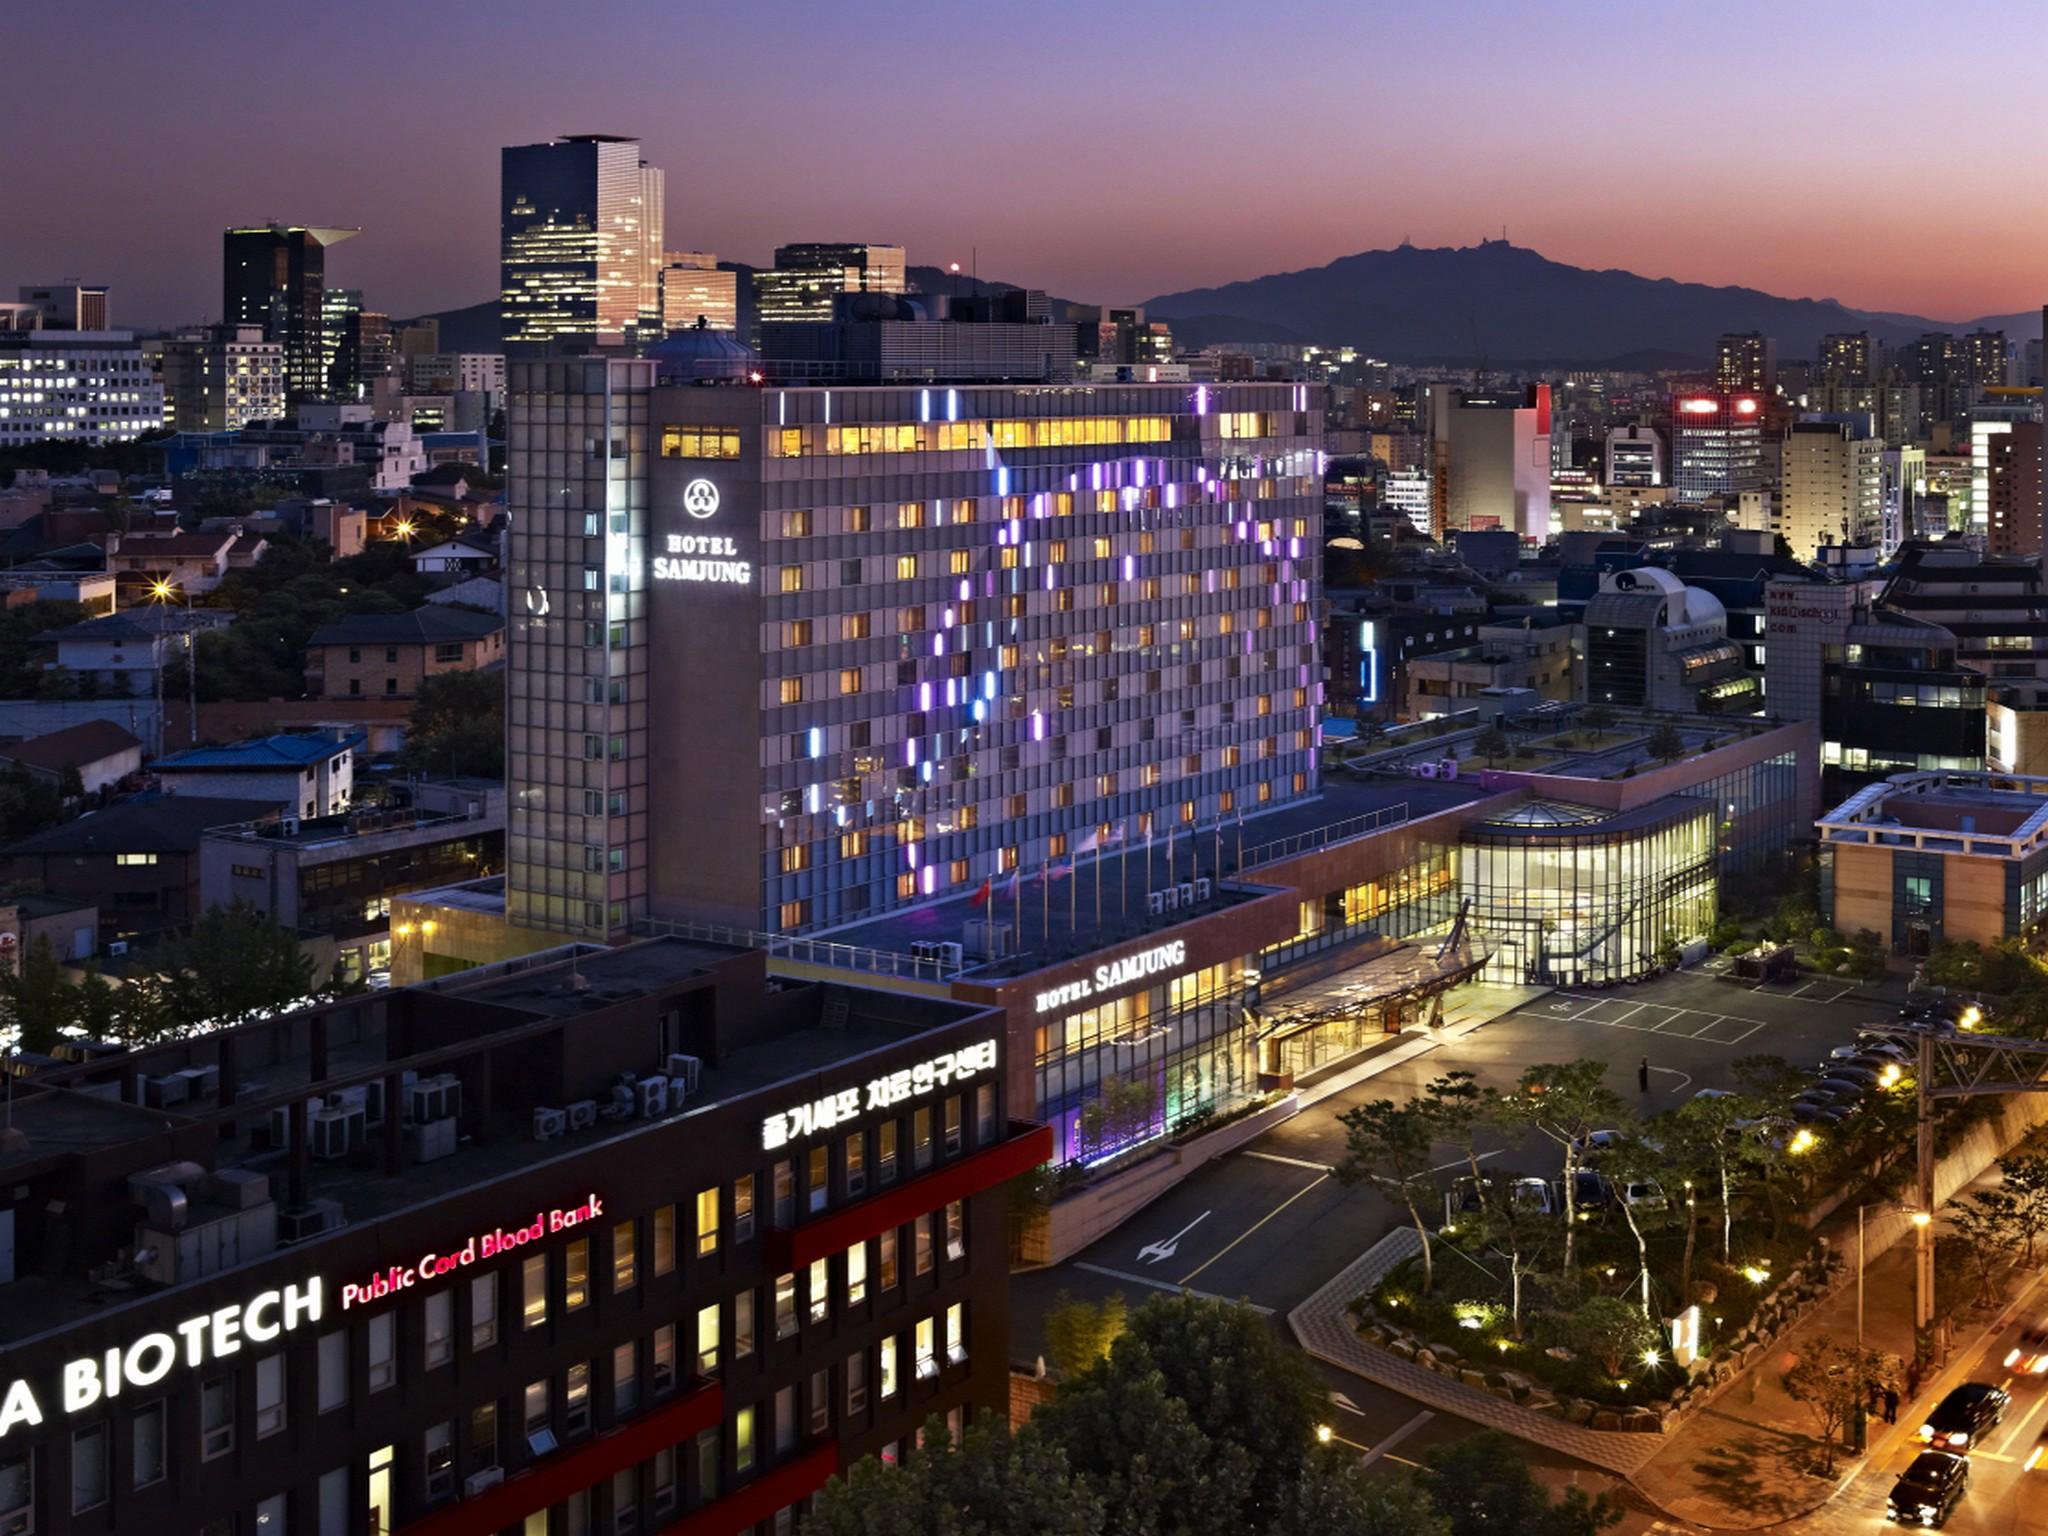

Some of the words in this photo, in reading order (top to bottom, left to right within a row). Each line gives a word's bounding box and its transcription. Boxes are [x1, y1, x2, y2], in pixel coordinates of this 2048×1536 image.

[653, 557, 751, 584] SAMJUNG
[667, 534, 737, 556] HOTEL
[1035, 979, 1092, 1013] HOTEL
[1095, 939, 1186, 992] SAMJUNG
[762, 1087, 860, 1150] 줄기세포
[865, 1038, 998, 1110] 치료연구센터
[342, 1265, 415, 1310] Public
[418, 1237, 476, 1280] Cord
[481, 1213, 544, 1259] Blood
[549, 1192, 603, 1233] Bank
[63, 1275, 323, 1413] BIOTECH
